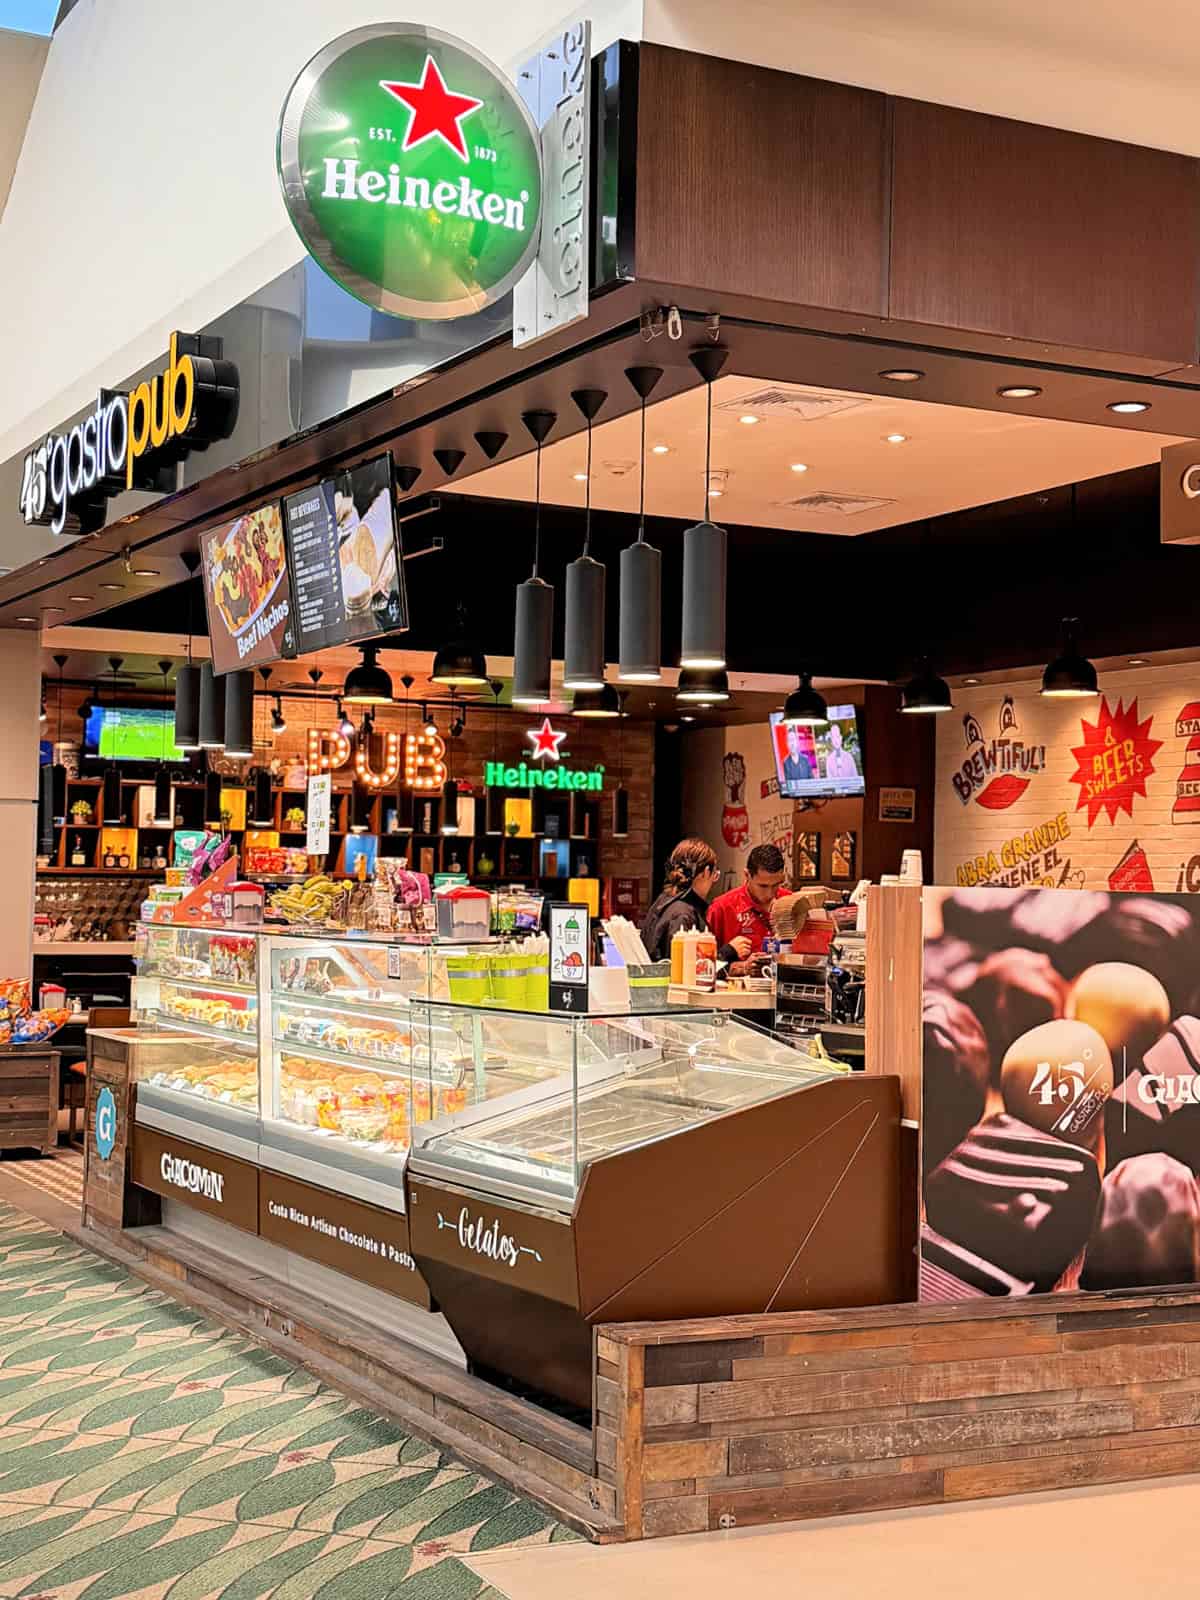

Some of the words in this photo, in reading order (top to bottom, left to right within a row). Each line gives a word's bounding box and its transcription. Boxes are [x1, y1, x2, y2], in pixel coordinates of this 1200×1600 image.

[369, 127, 397, 142] EST.
[474, 145, 497, 162] 1873
[320, 158, 526, 231] Heineken
[237, 622, 258, 658] Beef
[256, 600, 289, 640] Nachos
[307, 728, 448, 789] PUB
[484, 762, 604, 790] Heineken
[952, 738, 1046, 805] BREWTIFUL!
[1086, 754, 1144, 800] SWEETS
[1093, 739, 1136, 776] BEER
[956, 850, 1001, 887] ABRA
[1000, 811, 1070, 868] GRANDE
[1044, 848, 1063, 872] EL
[99, 1106, 112, 1141] G
[268, 1200, 288, 1218] Costa
[289, 1207, 309, 1226] Rican
[311, 1215, 337, 1238] Artisan
[339, 1226, 378, 1254] Chocolate
[380, 1242, 387, 1257] &
[389, 1245, 416, 1271] Pastry
[458, 1207, 520, 1267] Gelatos
